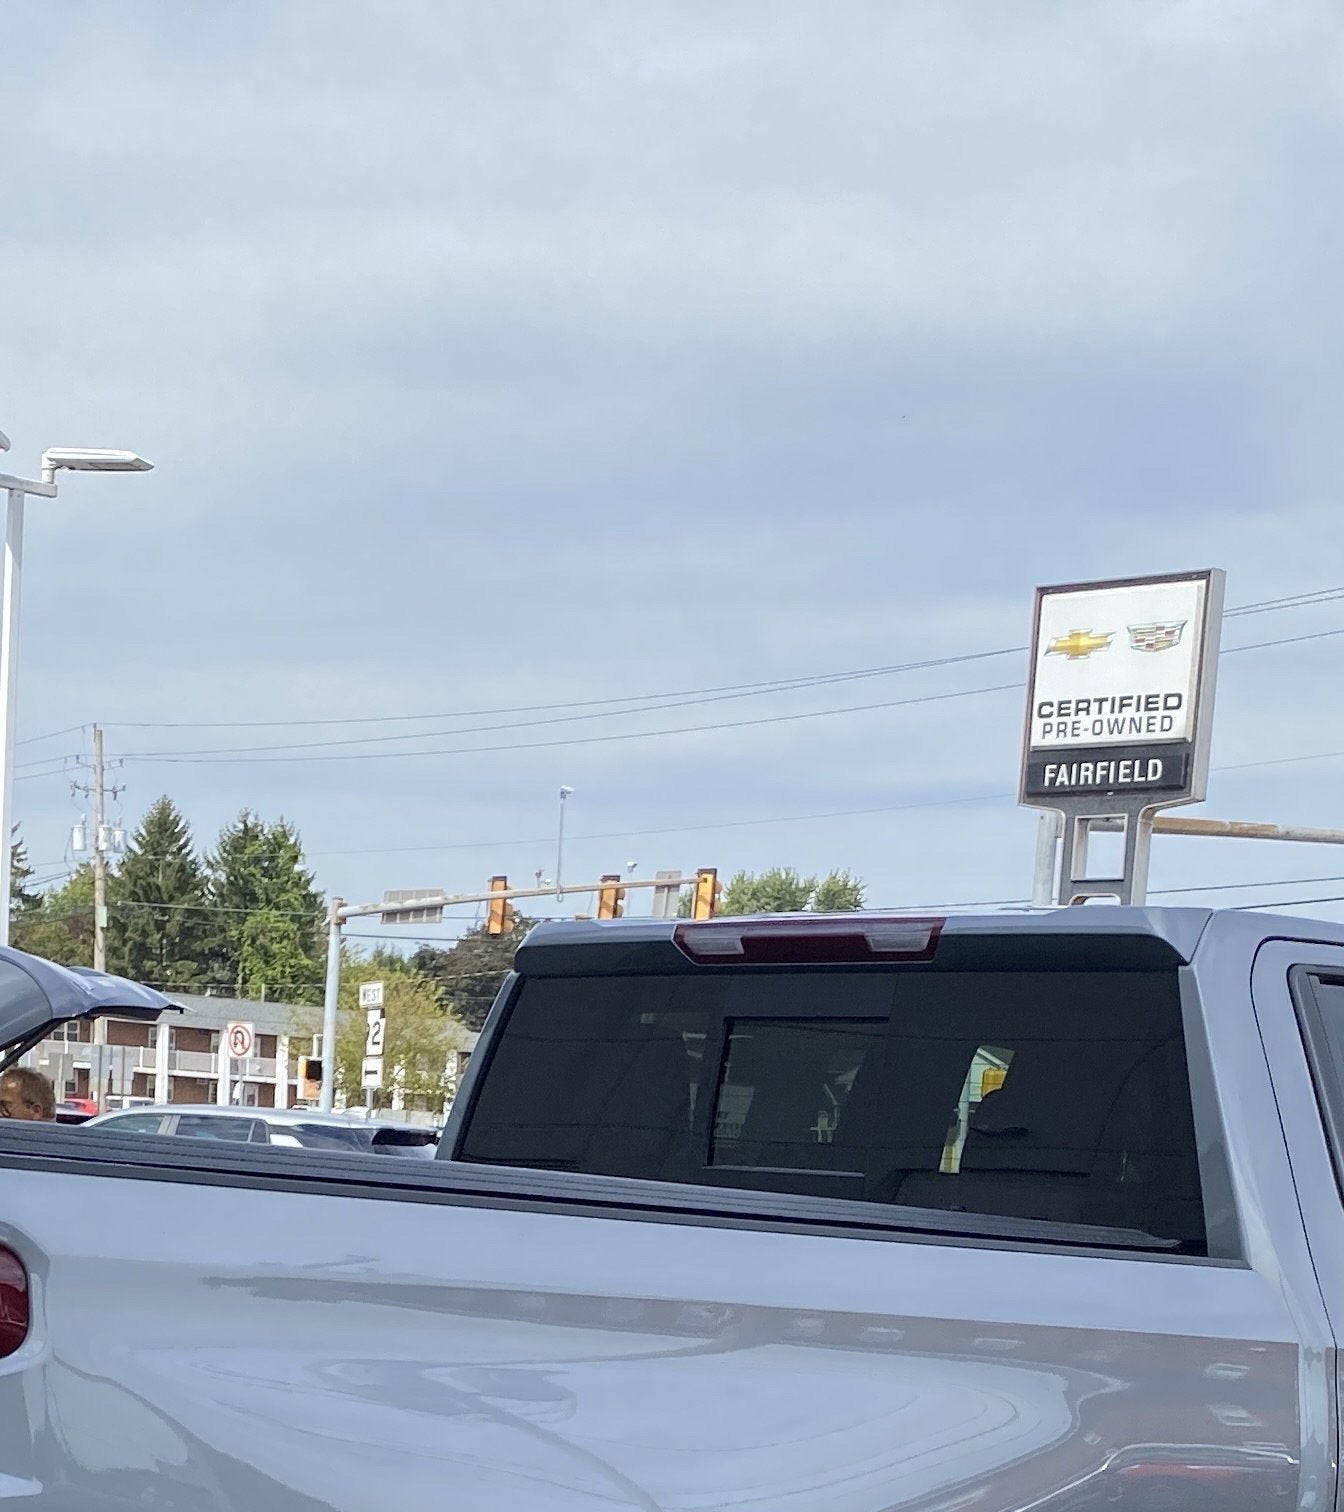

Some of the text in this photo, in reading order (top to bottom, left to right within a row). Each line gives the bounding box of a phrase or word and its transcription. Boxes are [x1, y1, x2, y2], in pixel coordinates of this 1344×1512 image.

[1037, 693, 1183, 719] CERTIFIED
[1042, 715, 1173, 739] PRE-OWNED
[1043, 758, 1164, 787] FAIRFIELD
